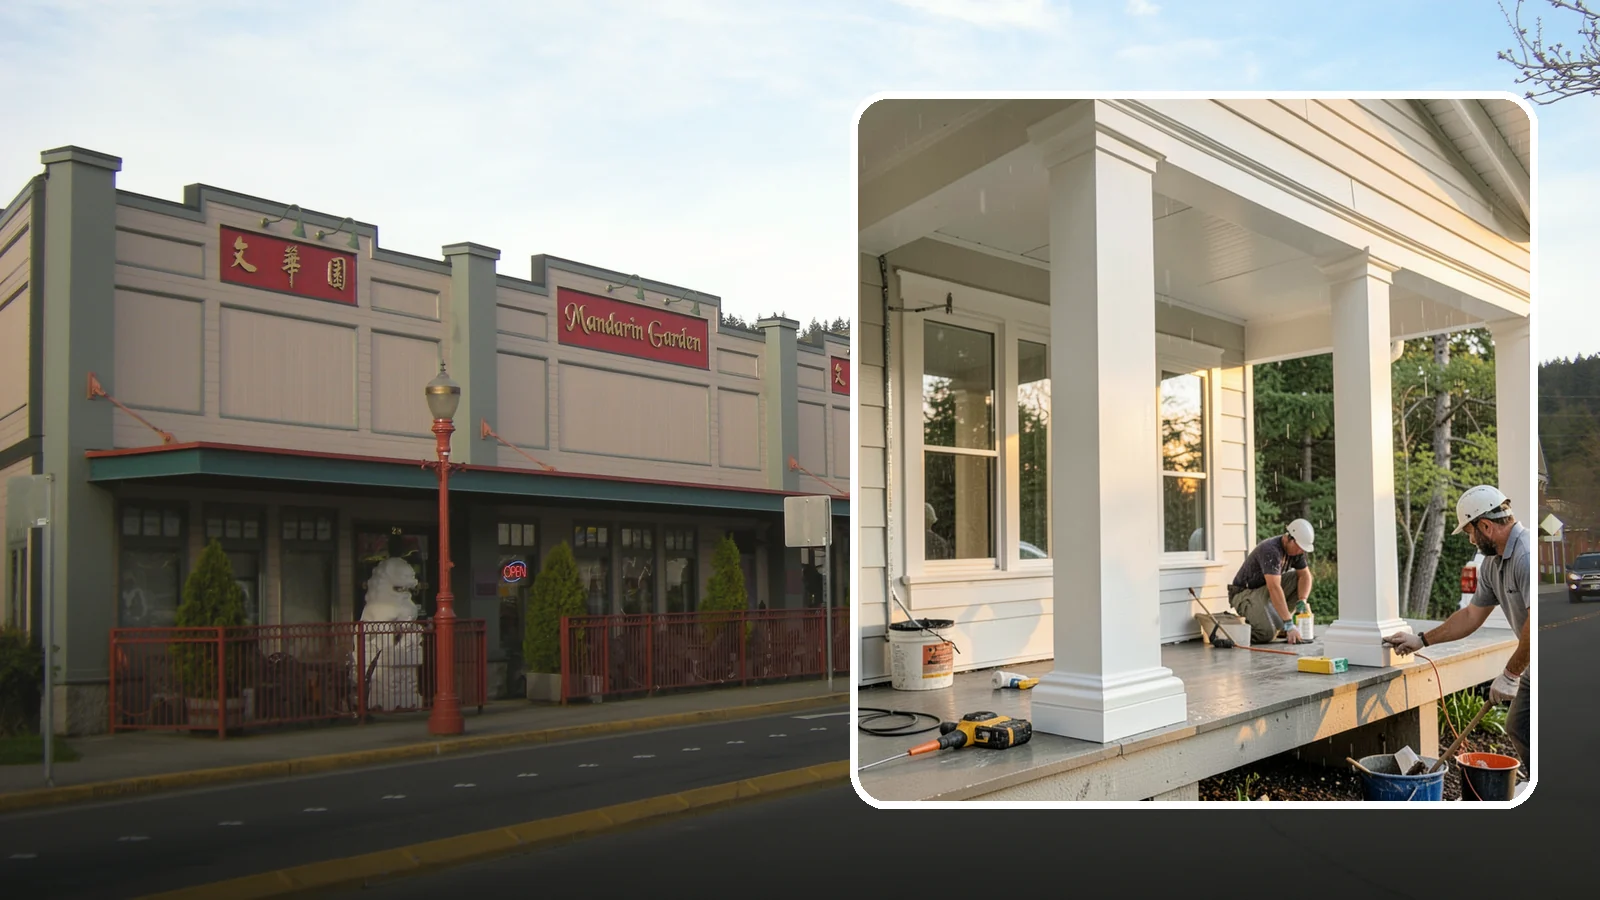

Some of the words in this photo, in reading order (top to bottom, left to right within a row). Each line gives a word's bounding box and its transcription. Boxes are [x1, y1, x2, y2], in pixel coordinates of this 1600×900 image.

[564, 302, 644, 341] Mandarin
[647, 320, 701, 352] Garden
[835, 363, 846, 386] 文
[503, 565, 527, 578] OPEN
